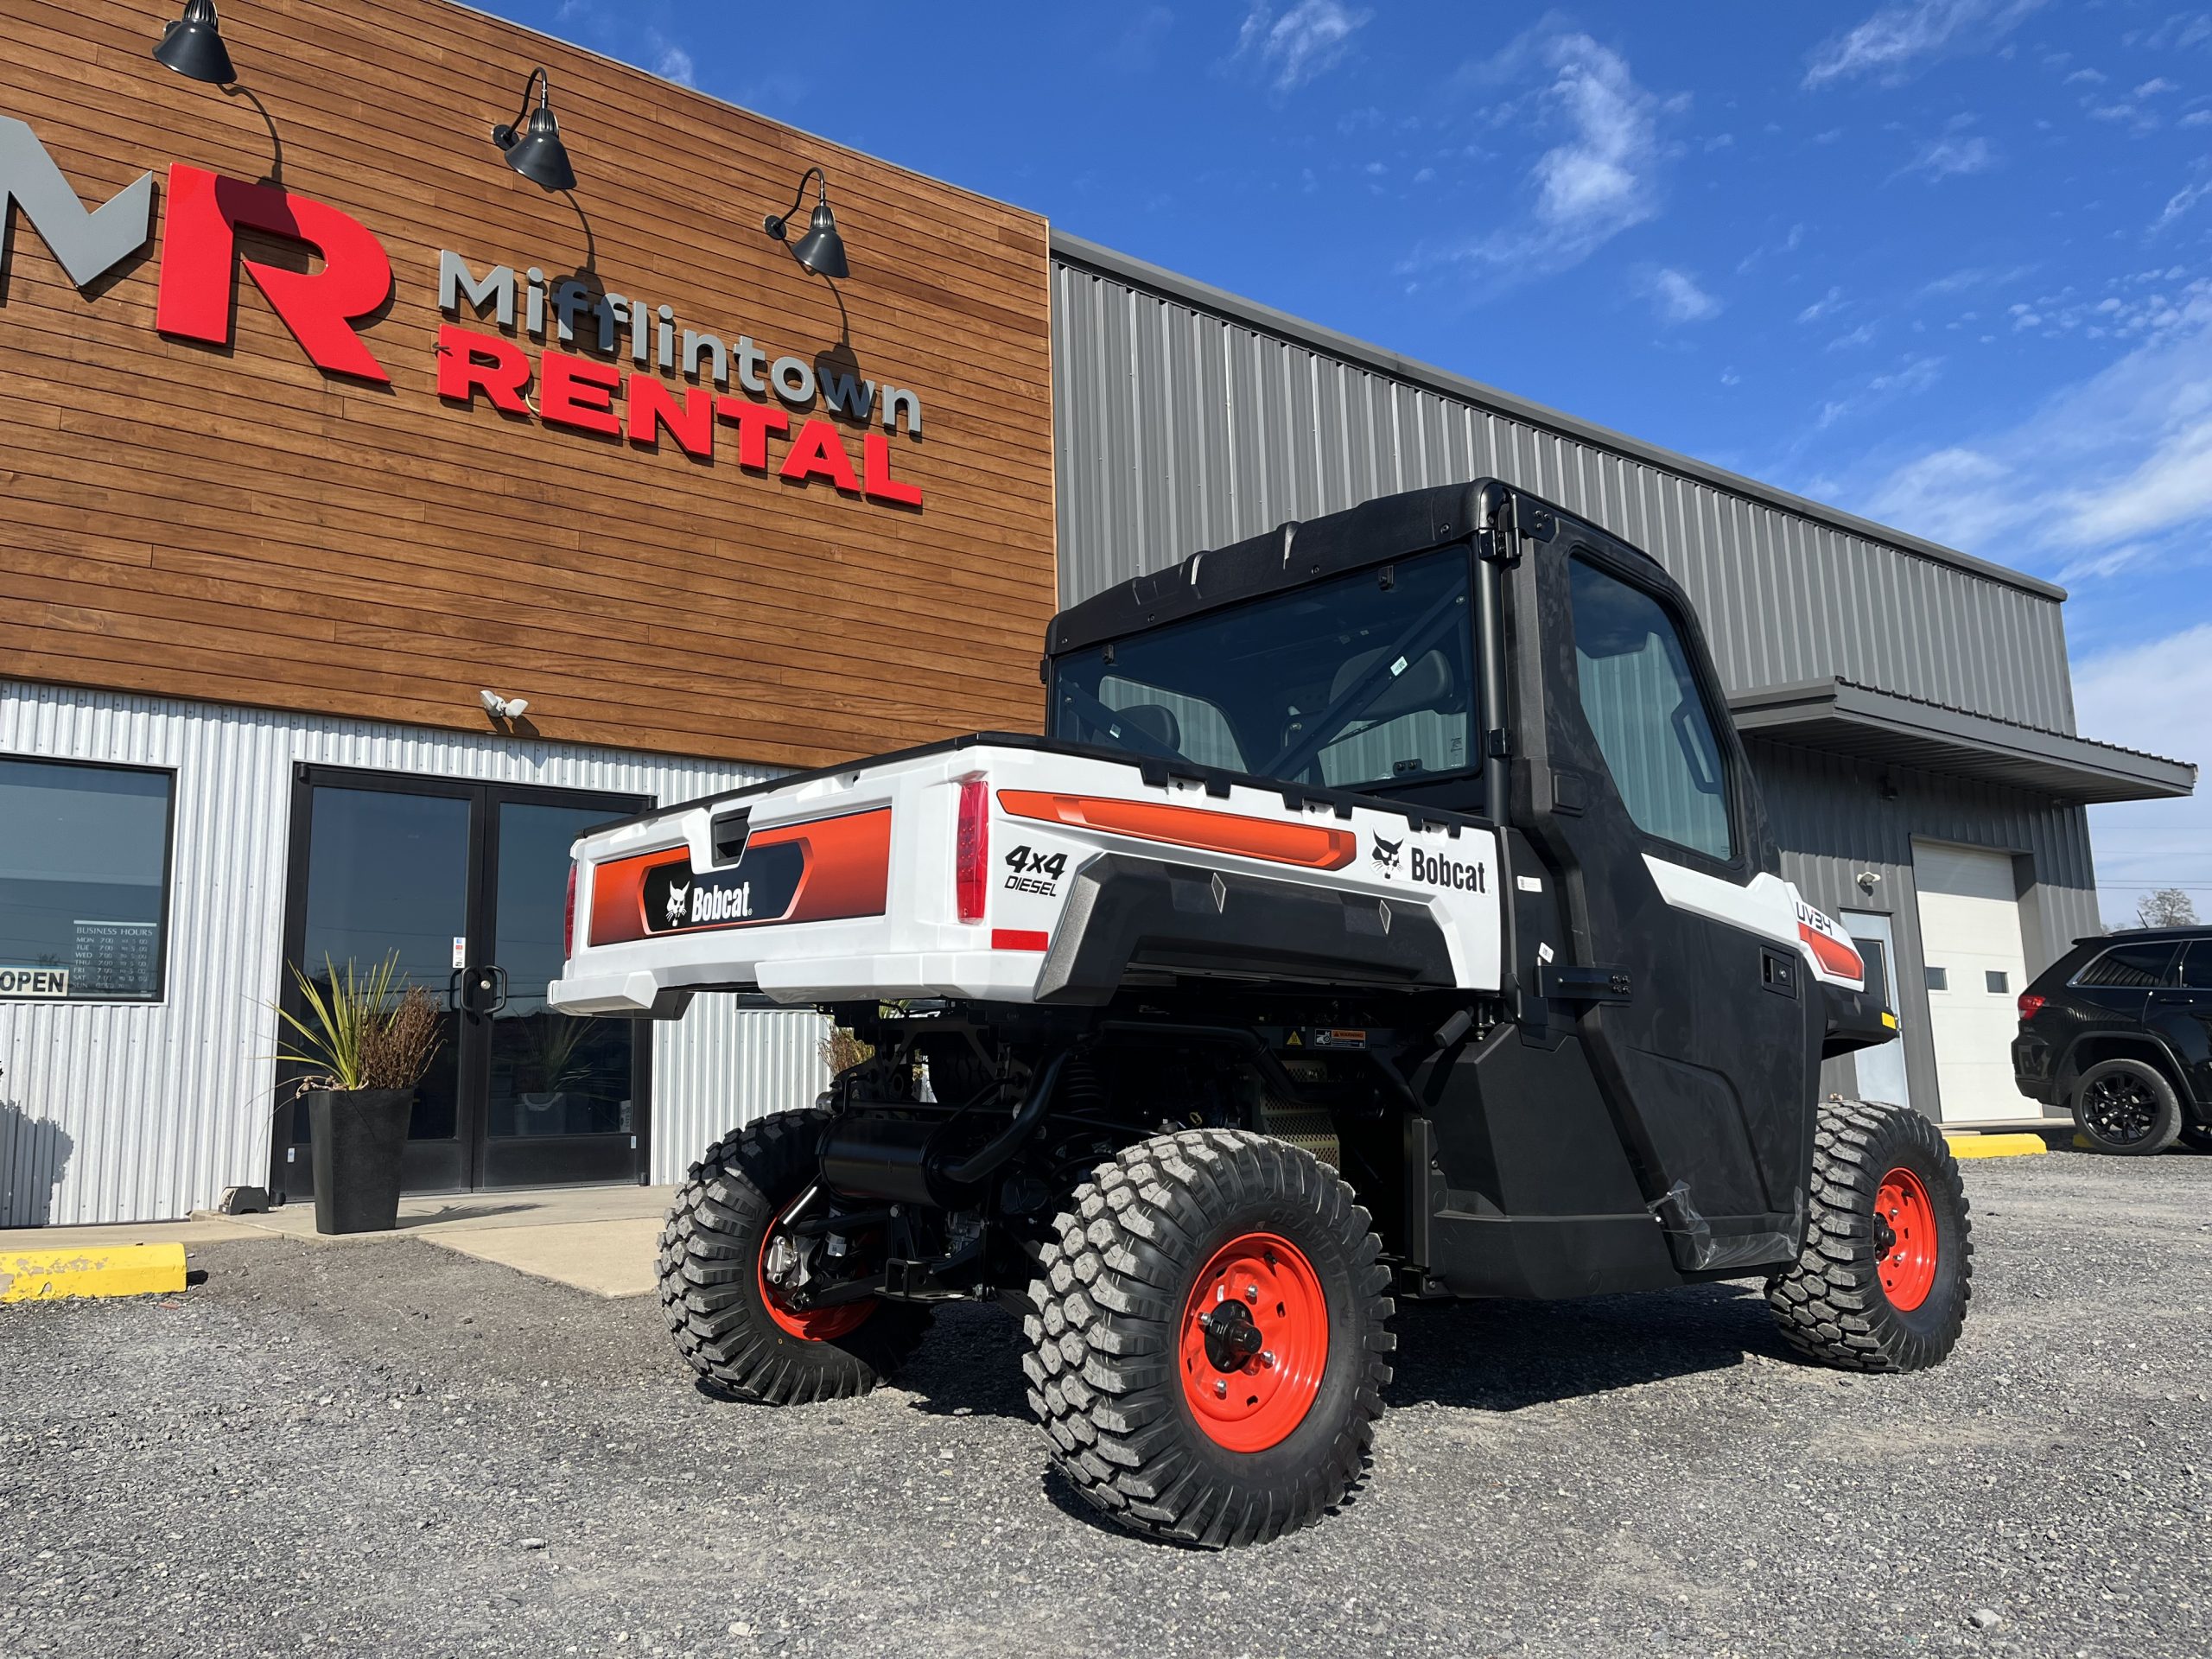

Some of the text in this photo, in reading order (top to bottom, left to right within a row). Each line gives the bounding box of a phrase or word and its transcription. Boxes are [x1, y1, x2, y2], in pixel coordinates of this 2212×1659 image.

[438, 249, 921, 433] Mifflintown
[437, 323, 922, 506] RENTAL
[1005, 844, 1068, 880] 4x4
[1411, 847, 1485, 893] Bobcat
[691, 881, 751, 923] Bobcat
[1004, 875, 1056, 897] DIESEL
[120, 928, 153, 937] HOURS
[1796, 901, 1833, 936] UV34
[0, 970, 65, 993] OPEN
